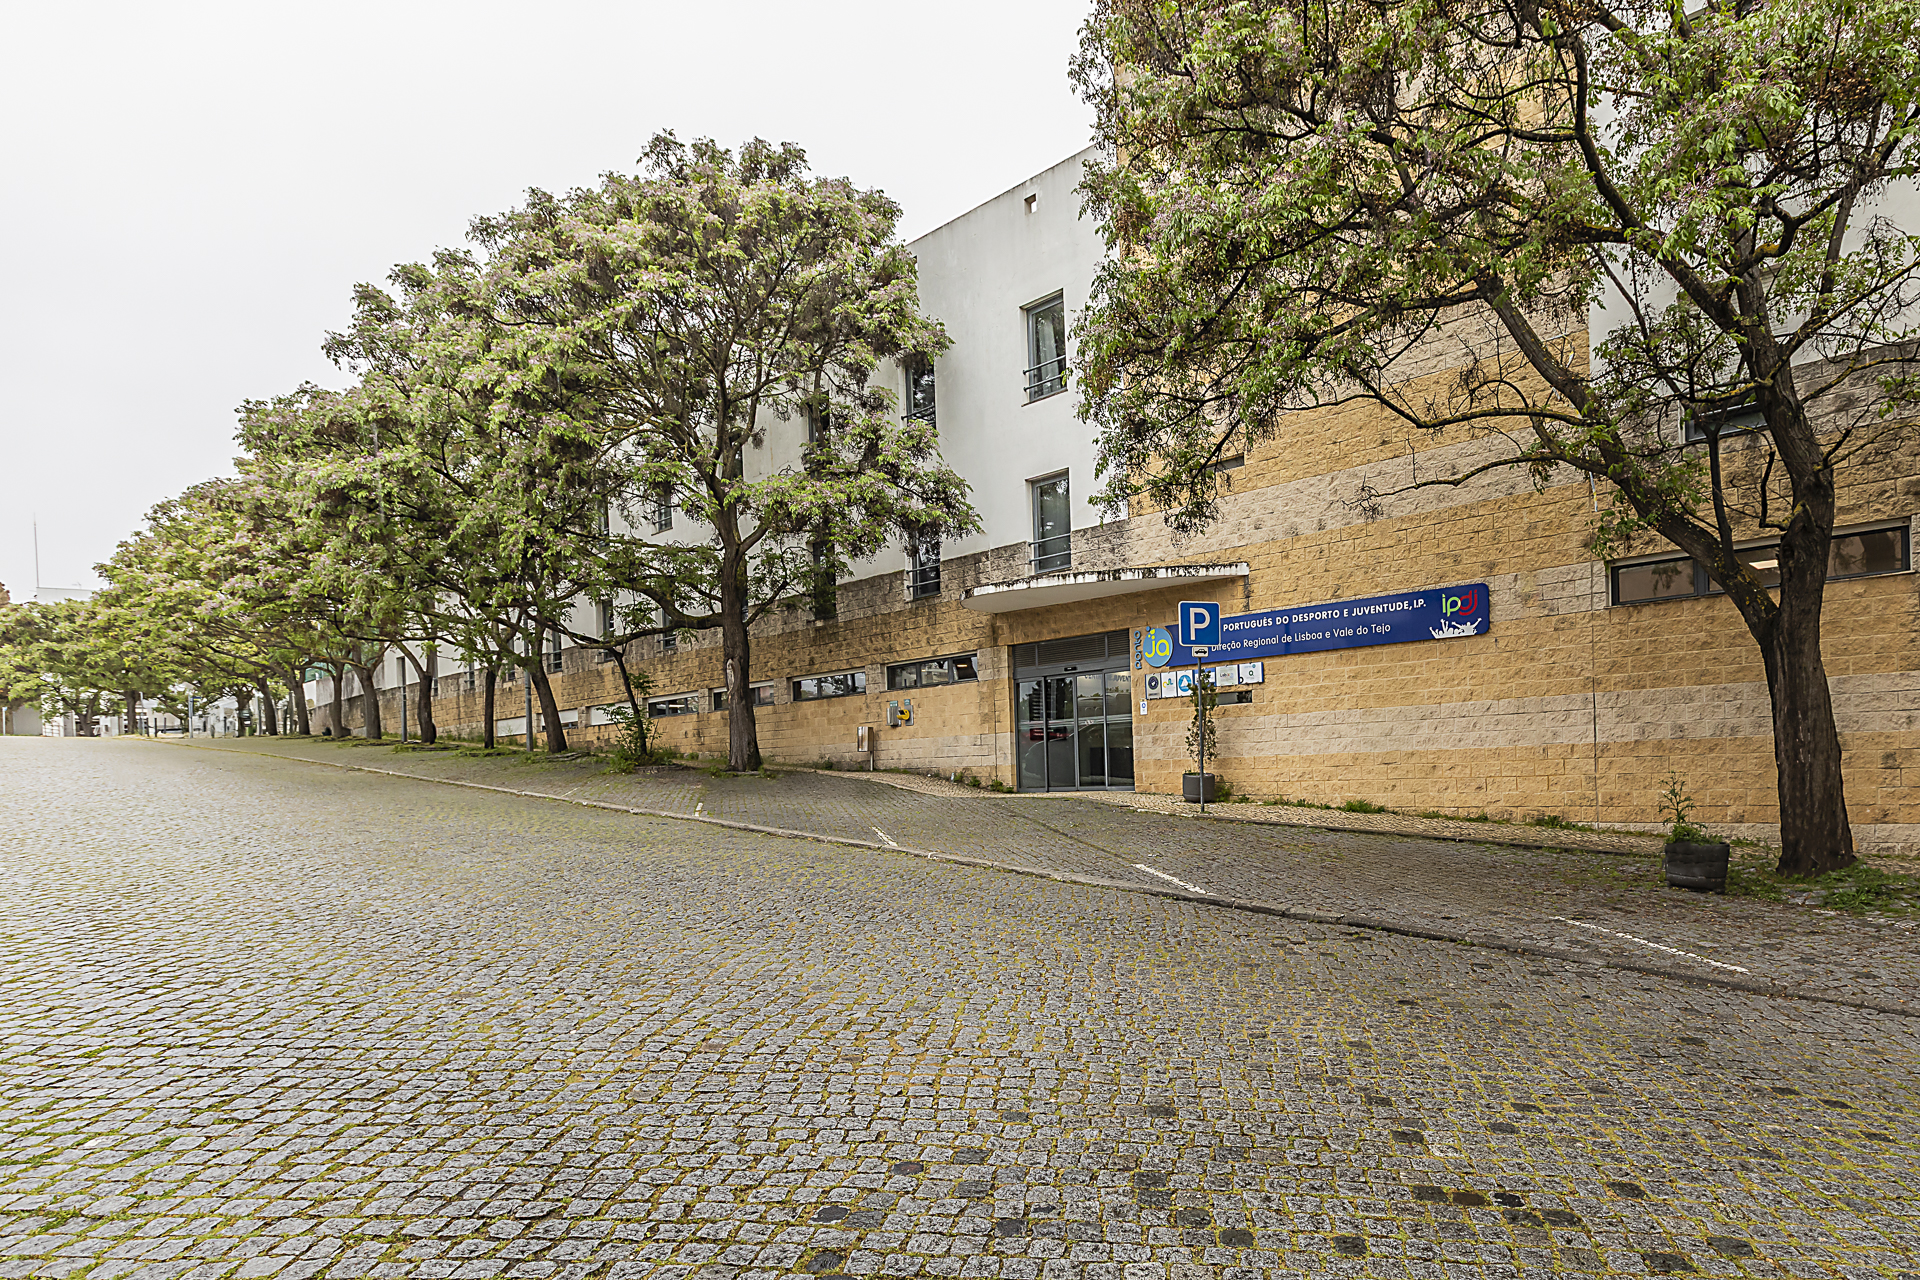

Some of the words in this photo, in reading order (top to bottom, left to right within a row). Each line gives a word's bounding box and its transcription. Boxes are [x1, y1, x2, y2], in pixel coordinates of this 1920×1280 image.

[1223, 616, 1273, 632] PORTUGUÊS
[1275, 615, 1289, 626] DO
[1292, 609, 1340, 623] DESPORTO
[1343, 608, 1349, 617] E
[1351, 600, 1412, 616] JUVENTUDE,
[1413, 598, 1426, 608] I.P.
[1442, 589, 1478, 617] ipdj
[1190, 608, 1210, 641] P
[1243, 634, 1279, 649] Regional
[1281, 633, 1292, 644] de
[1294, 630, 1323, 642] Lisboa
[1325, 631, 1331, 639] e
[1332, 626, 1354, 638] Vale
[1356, 625, 1369, 635] do
[1371, 623, 1391, 635] Tejo
[1133, 630, 1142, 670] ponto
